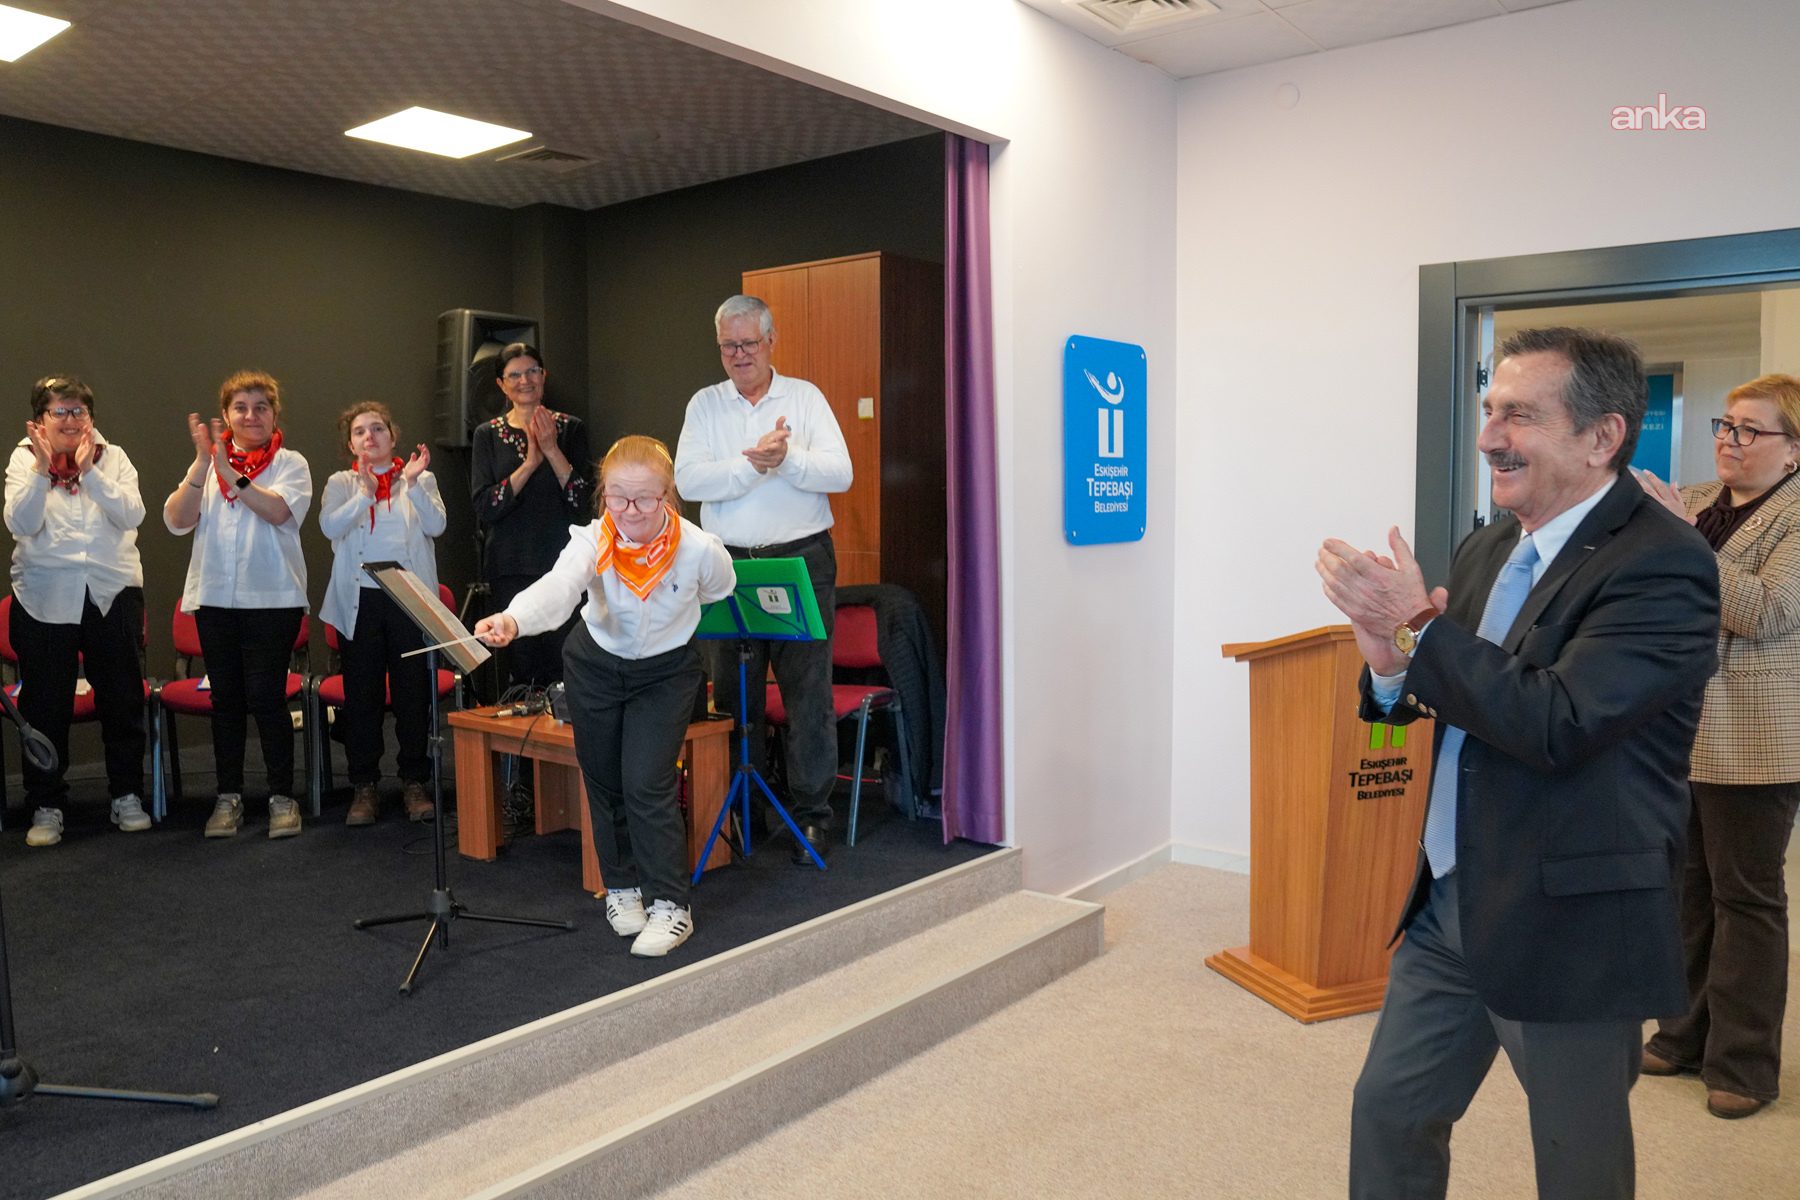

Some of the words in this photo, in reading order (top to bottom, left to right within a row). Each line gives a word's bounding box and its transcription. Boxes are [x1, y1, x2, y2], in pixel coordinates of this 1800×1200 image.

[1094, 463, 1129, 479] ESKİŞEHİR
[1086, 478, 1133, 500] TEPEBAŞI
[1348, 769, 1413, 788] TEPEBAŞI
